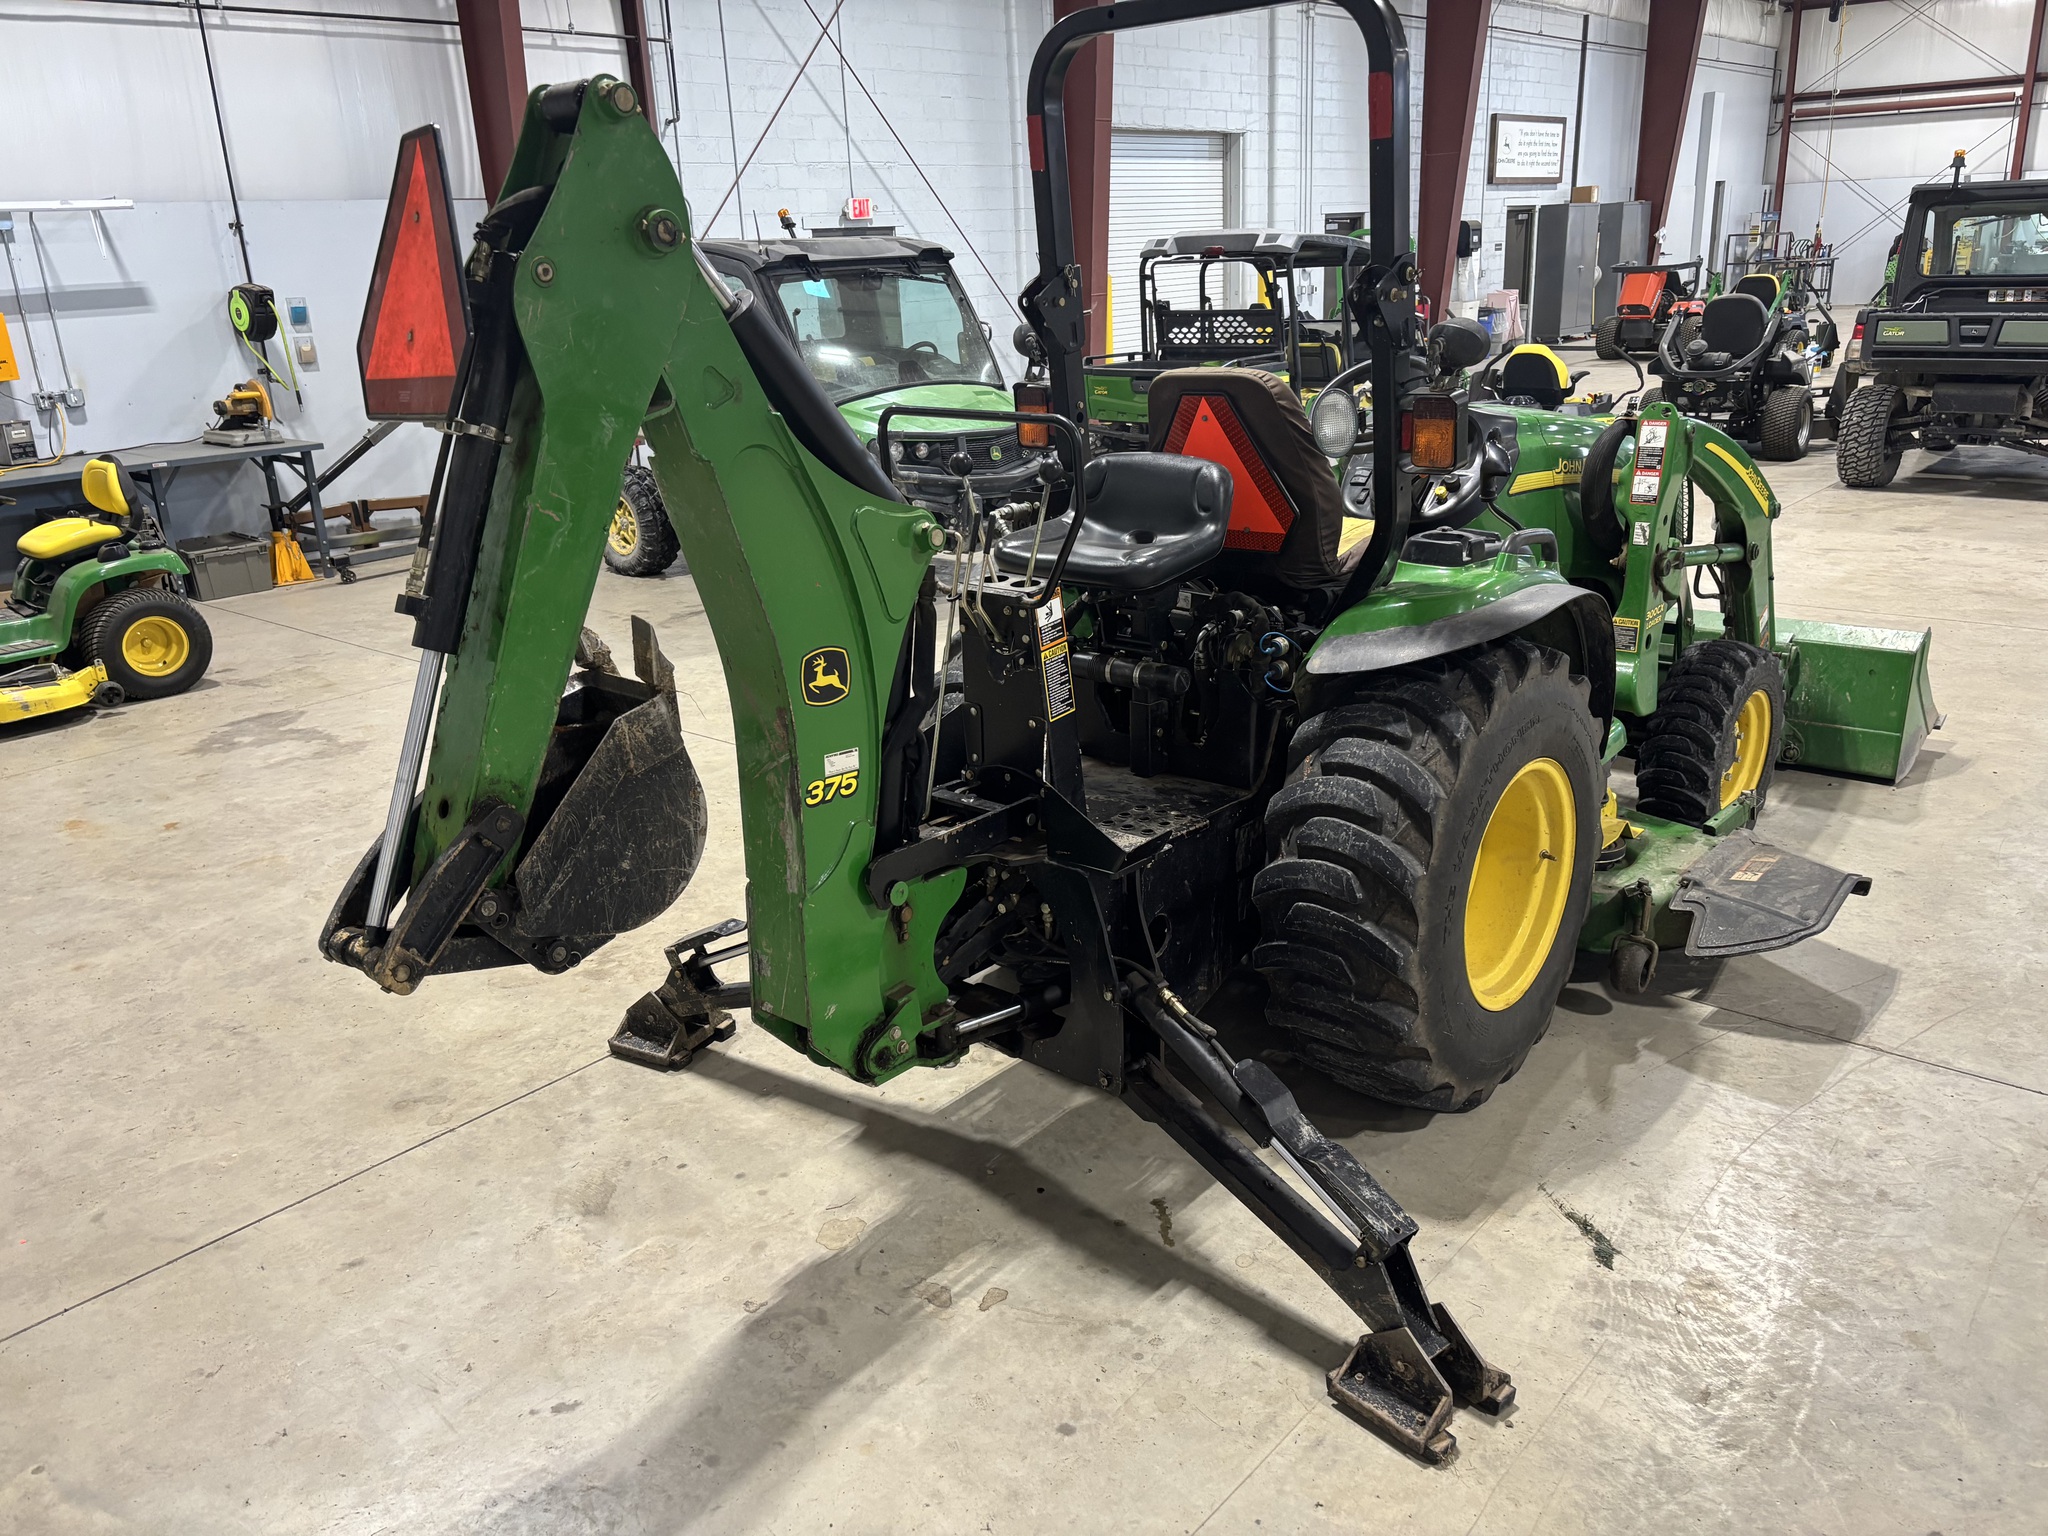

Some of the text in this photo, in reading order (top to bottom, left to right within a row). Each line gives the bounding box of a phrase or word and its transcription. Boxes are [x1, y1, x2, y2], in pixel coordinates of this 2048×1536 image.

[852, 199, 870, 218] EXIT
[1554, 457, 1582, 473] JOHN
[1048, 643, 1067, 658] CAUTION
[804, 770, 859, 807] 375
